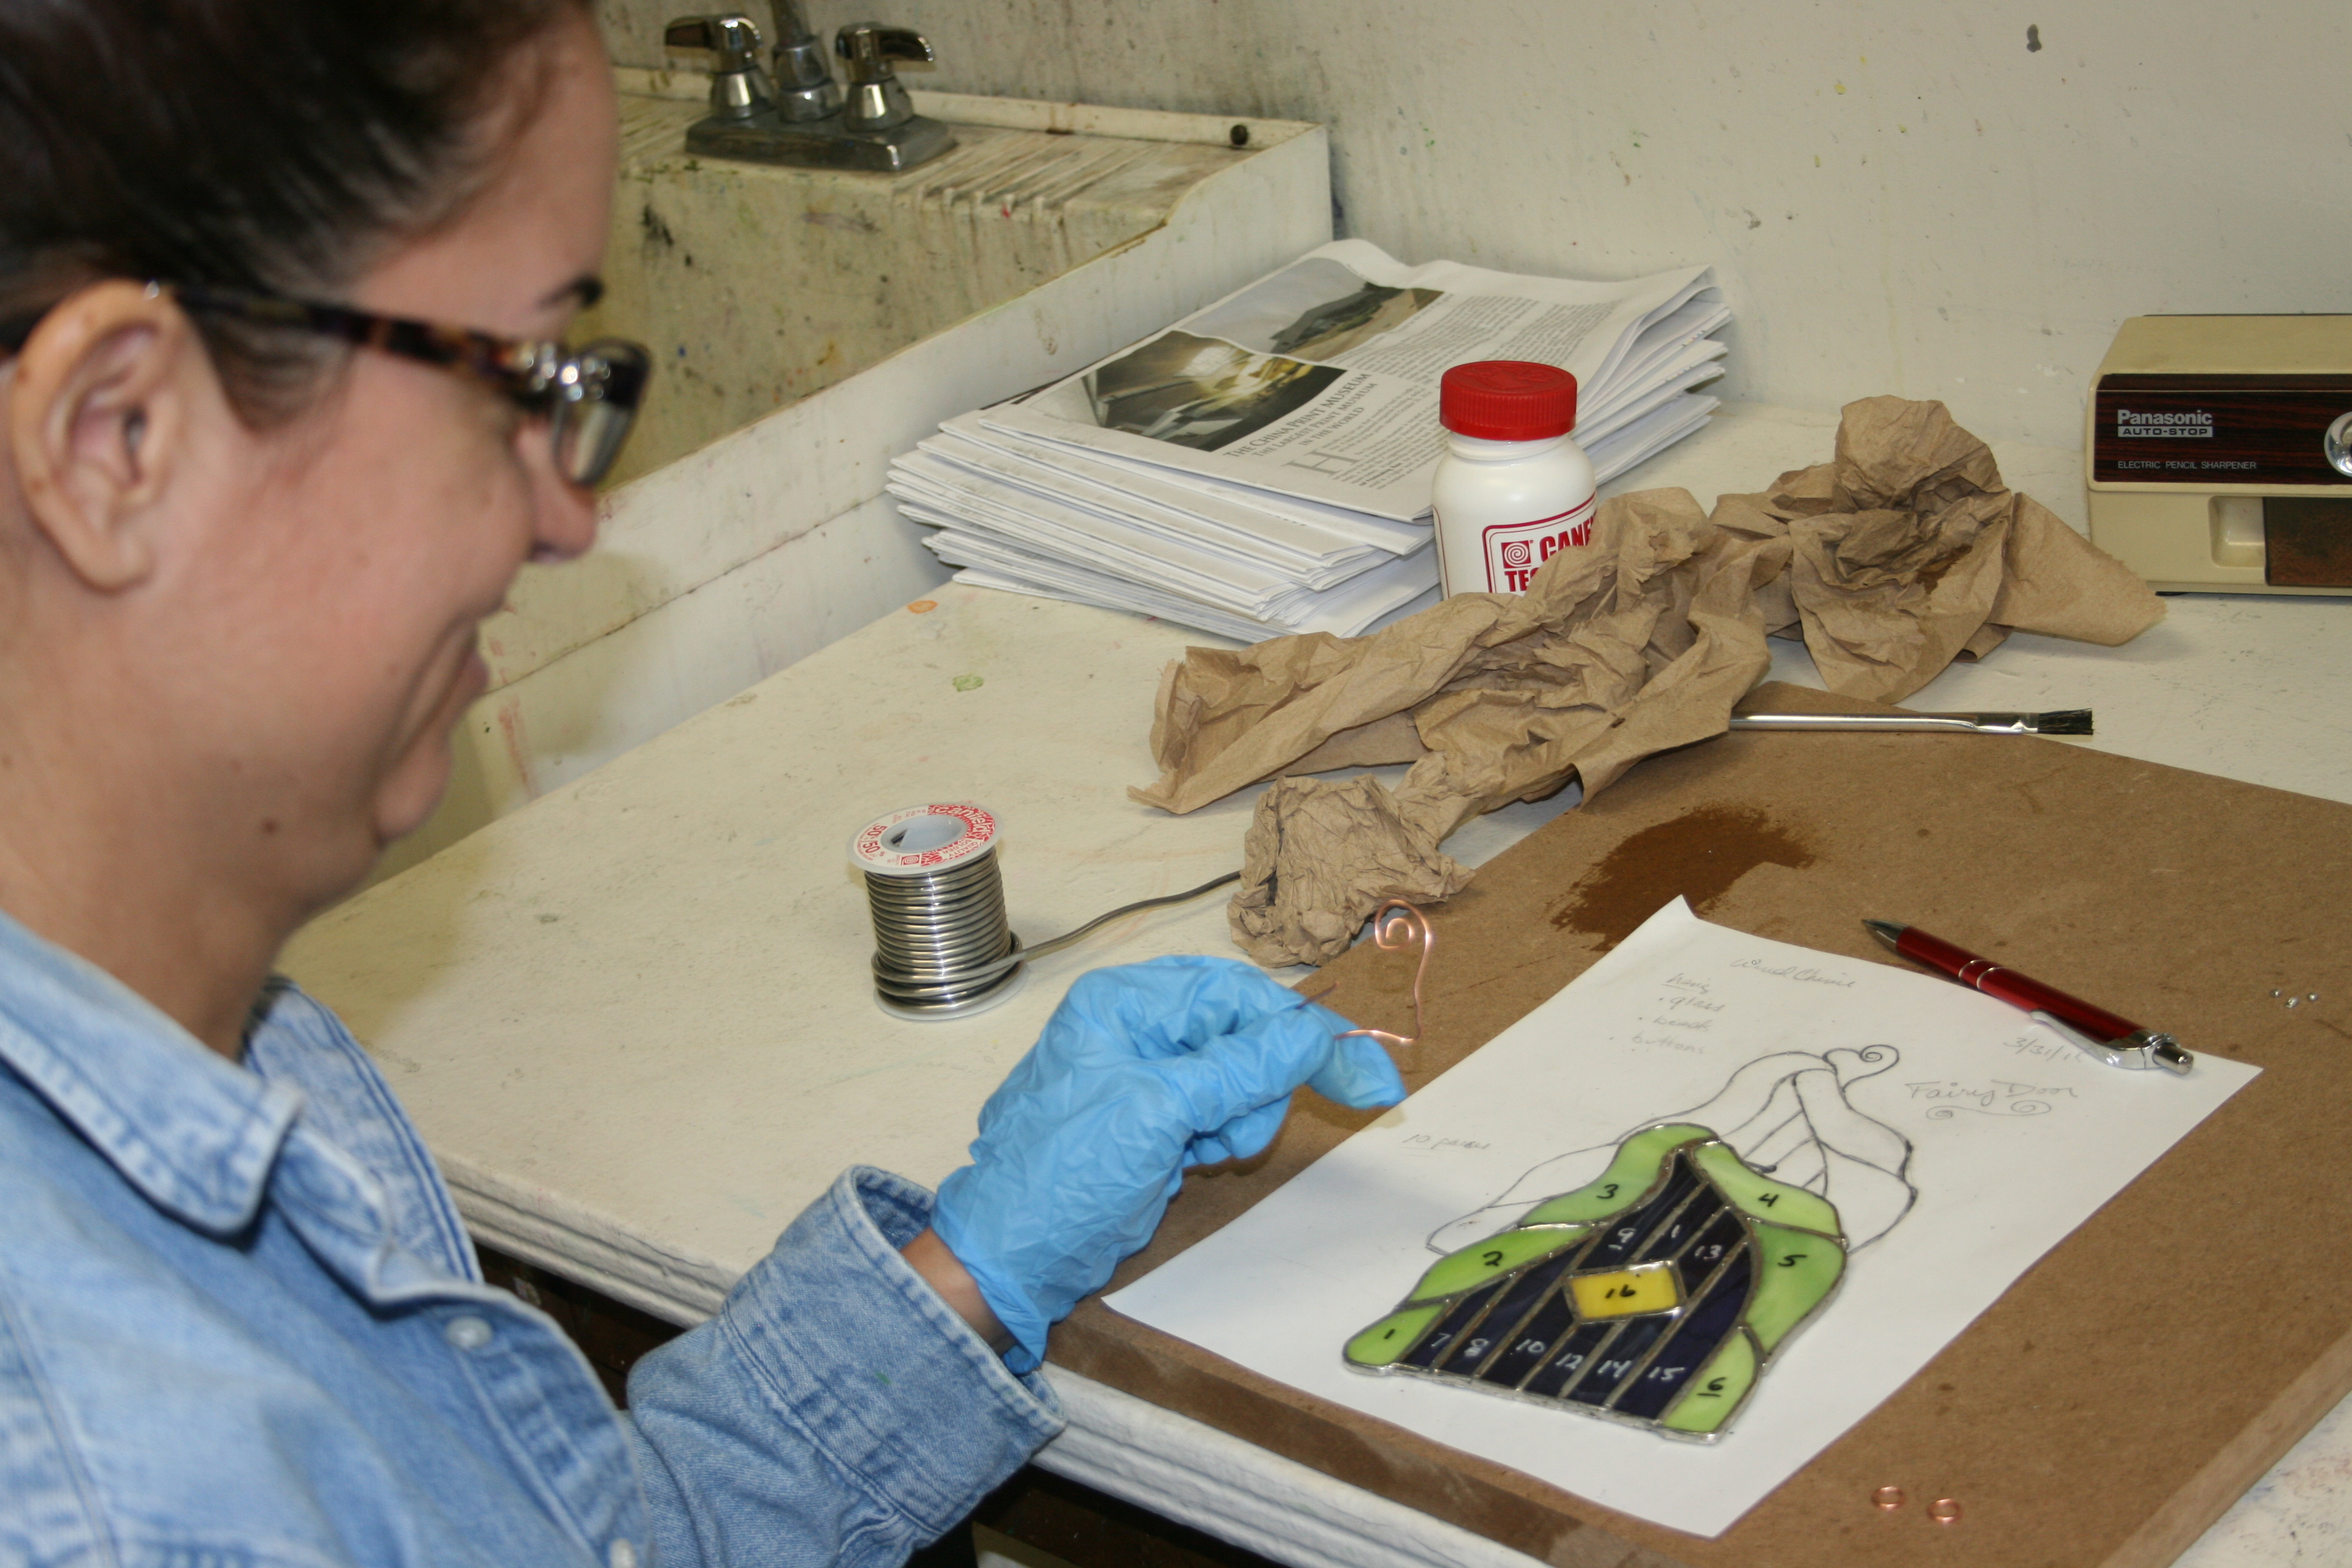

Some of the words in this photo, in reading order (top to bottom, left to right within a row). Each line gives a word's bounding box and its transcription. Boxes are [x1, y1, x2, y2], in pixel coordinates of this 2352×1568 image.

[1223, 445, 1256, 457] THE
[1249, 427, 1294, 446] CHINA
[1285, 407, 1325, 427] PRINT
[1319, 373, 1371, 408] MUSEUM
[1251, 447, 1277, 456] THE
[1272, 428, 1313, 448] LARGEST
[1309, 411, 1341, 428] PRINT
[1337, 383, 1377, 411] MUSEUM
[1311, 429, 1333, 439] THE
[1327, 407, 1364, 429] WORLD
[2117, 409, 2212, 425] Panasonic
[2201, 461, 2257, 469] SHARPENER
[948, 841, 979, 858] QUALITY
[1596, 1184, 1619, 1200] 3
[1758, 1193, 1780, 1207] 4
[1482, 1250, 1503, 1266] 2
[1694, 1244, 1722, 1260] 13
[1777, 1254, 1808, 1267] 5
[1605, 1284, 1636, 1299] 16
[1383, 1328, 1396, 1340] 1
[1431, 1333, 1452, 1349] 7
[1463, 1338, 1489, 1358] 8
[1516, 1338, 1546, 1354] 10
[1555, 1352, 1584, 1370] 12
[1597, 1359, 1633, 1379] 14
[1648, 1366, 1686, 1382] 15
